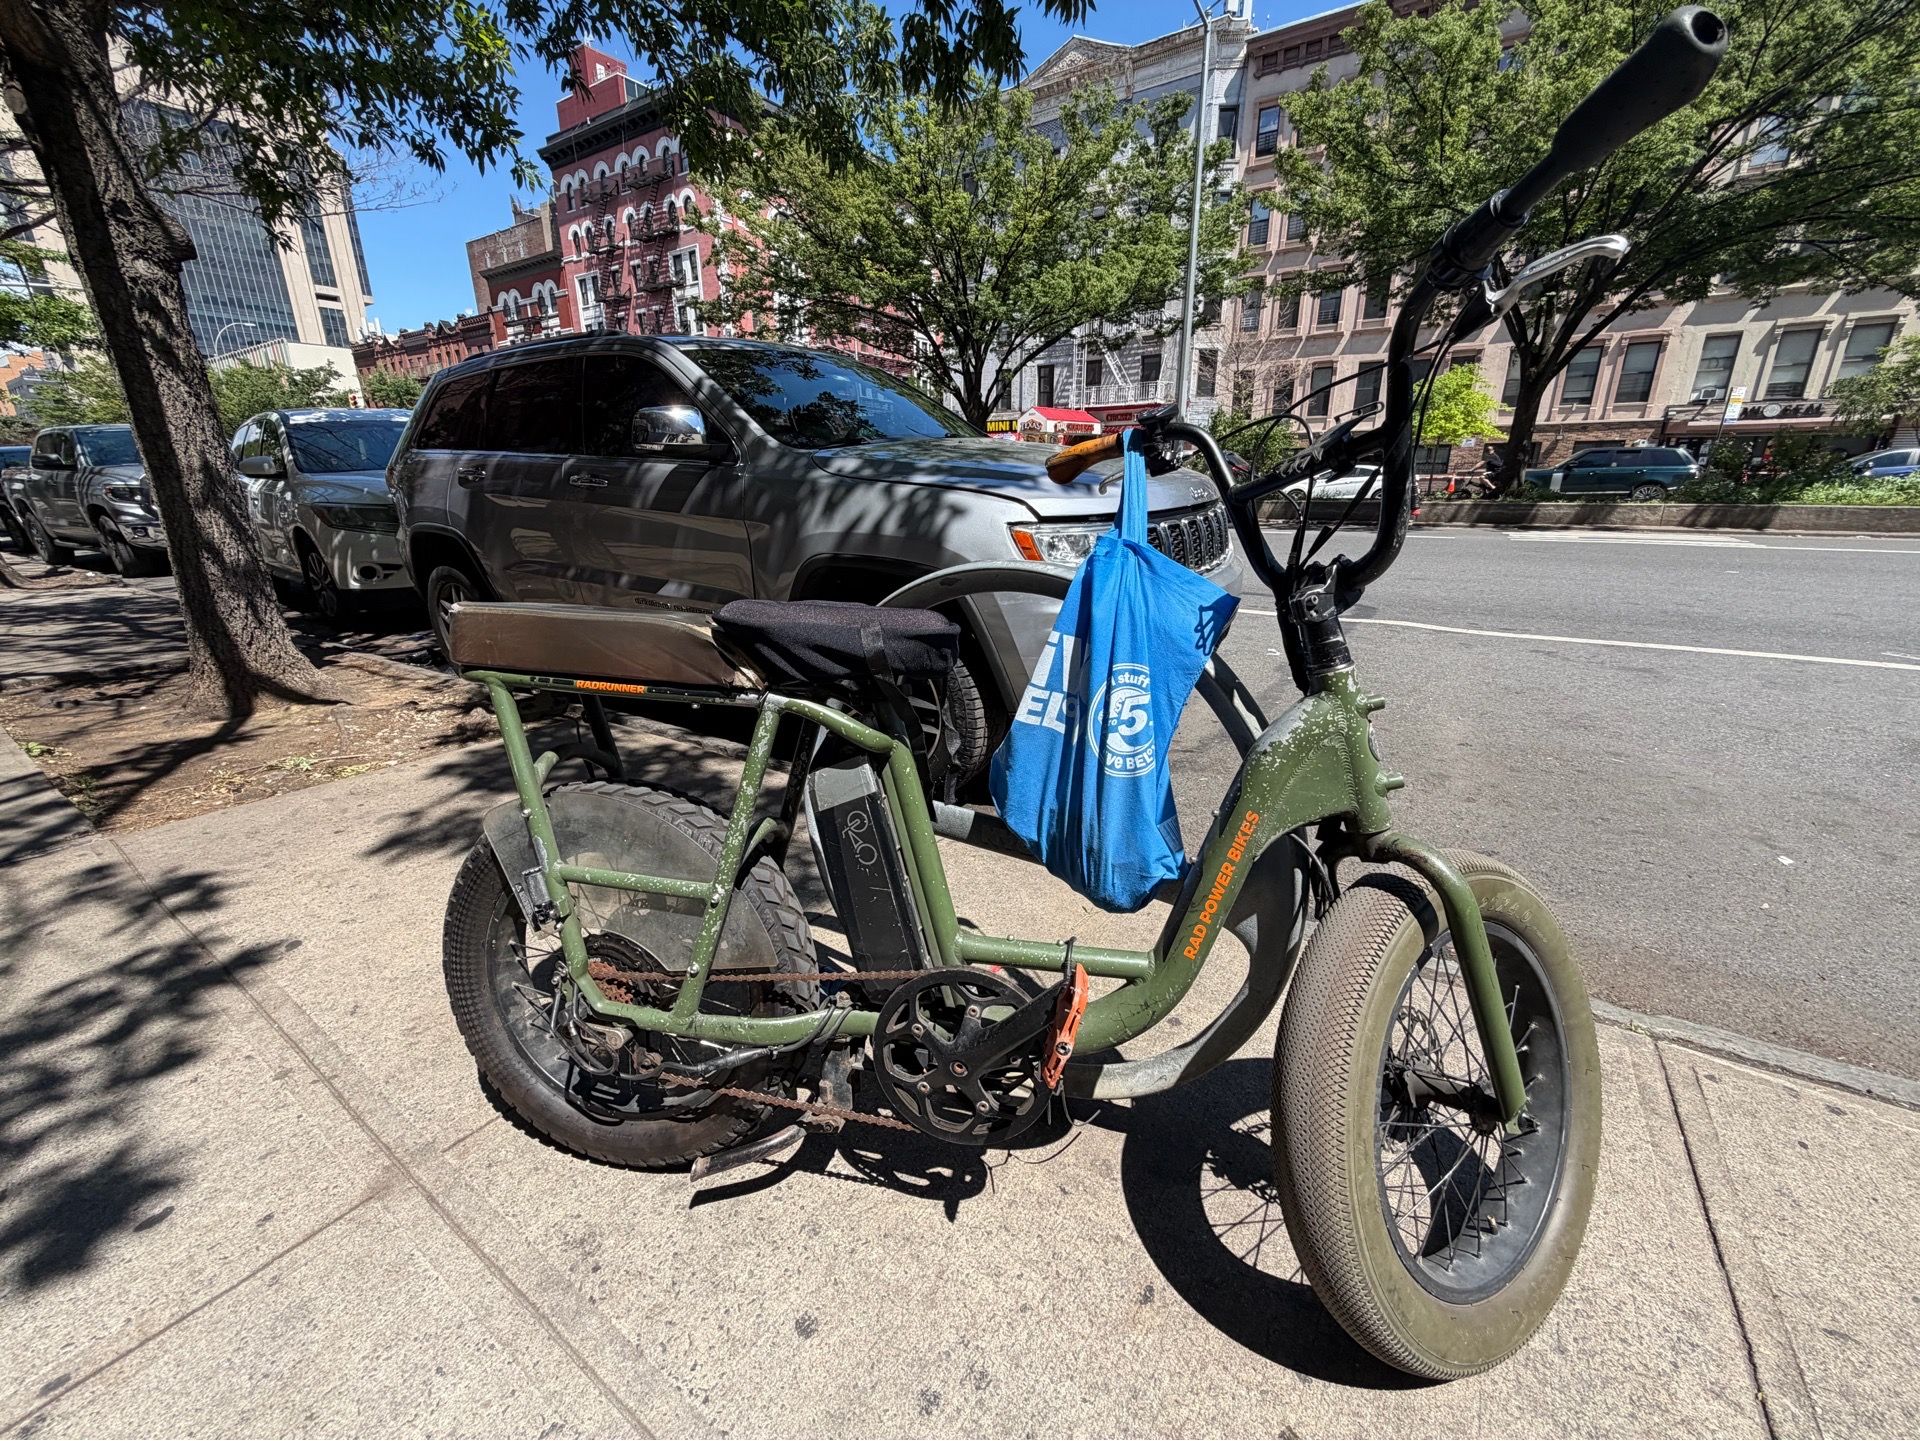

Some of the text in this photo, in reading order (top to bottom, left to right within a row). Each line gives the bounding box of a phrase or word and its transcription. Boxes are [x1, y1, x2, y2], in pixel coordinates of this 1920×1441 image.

[986, 421, 1010, 432] MINI
[1020, 420, 1042, 431] TEXAS
[1118, 671, 1151, 688] stuff
[576, 680, 645, 694] RADRUNNER
[1183, 810, 1260, 960] RAD POWER BIKES
